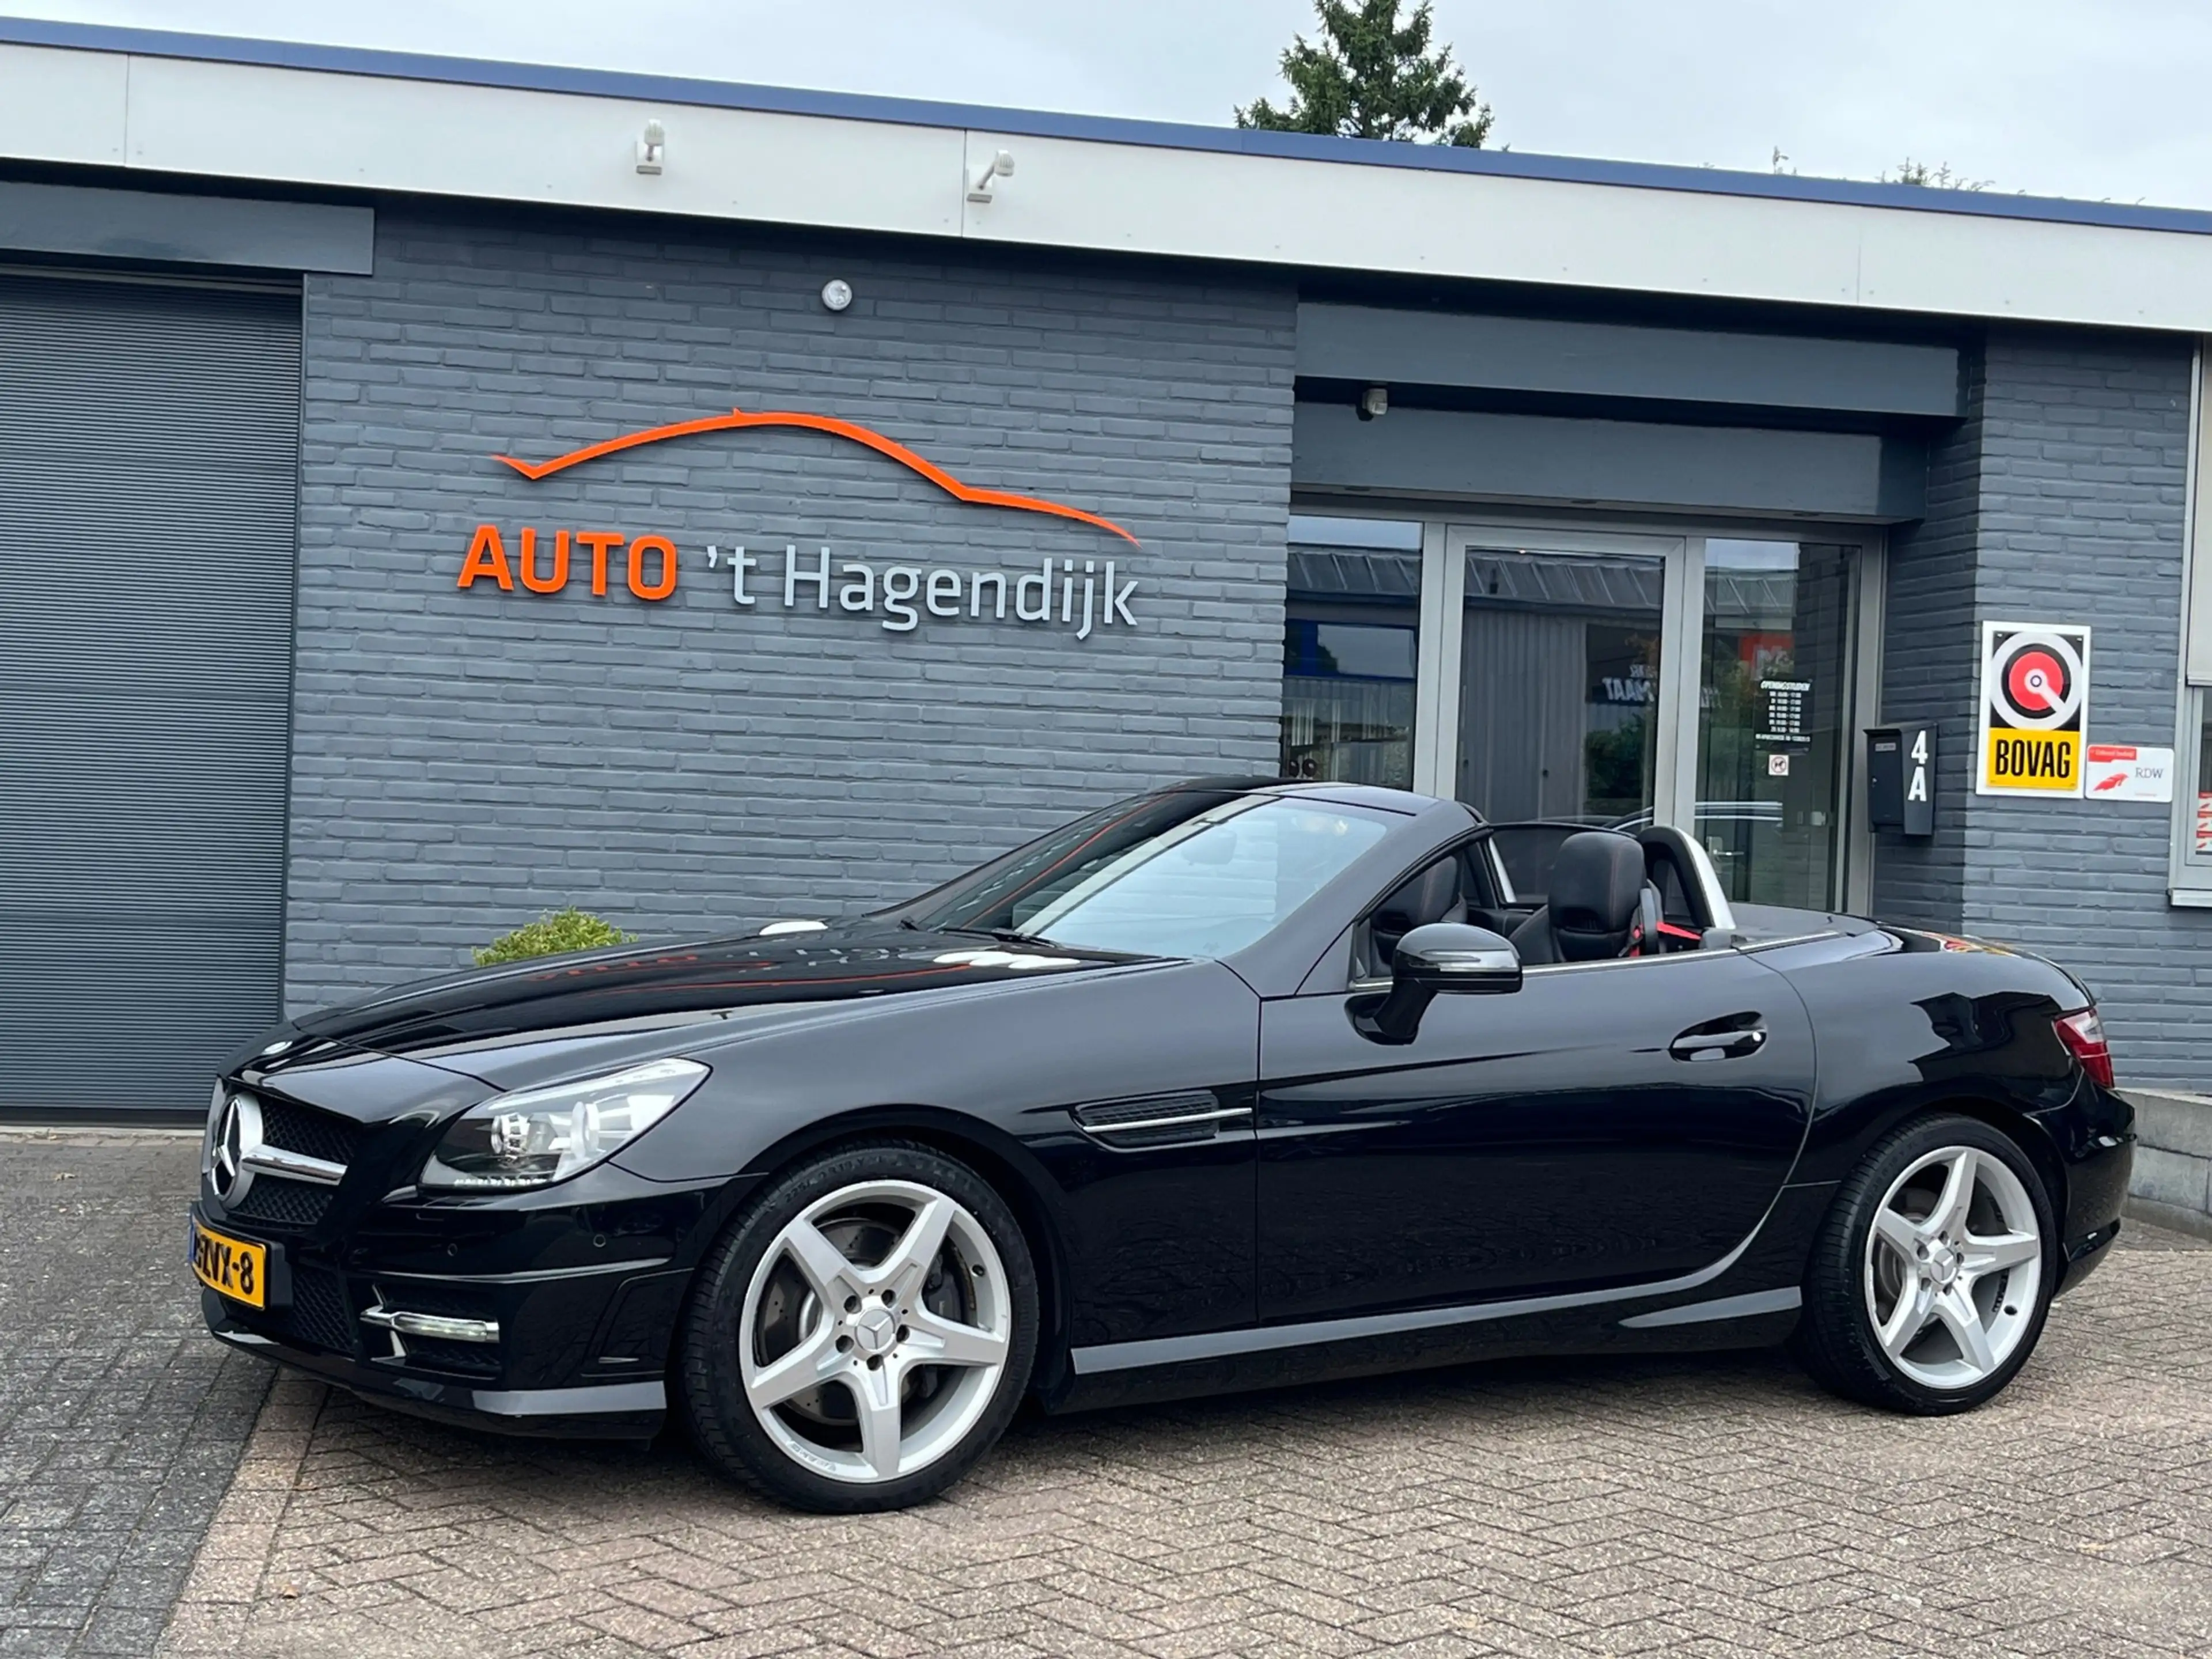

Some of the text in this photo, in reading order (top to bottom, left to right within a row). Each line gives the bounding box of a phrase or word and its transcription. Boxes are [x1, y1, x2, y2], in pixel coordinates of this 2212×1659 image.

[457, 525, 1138, 640] AUTO 't Hagendijk
[1995, 739, 2071, 778] BOVAG
[2135, 767, 2164, 778] RDW
